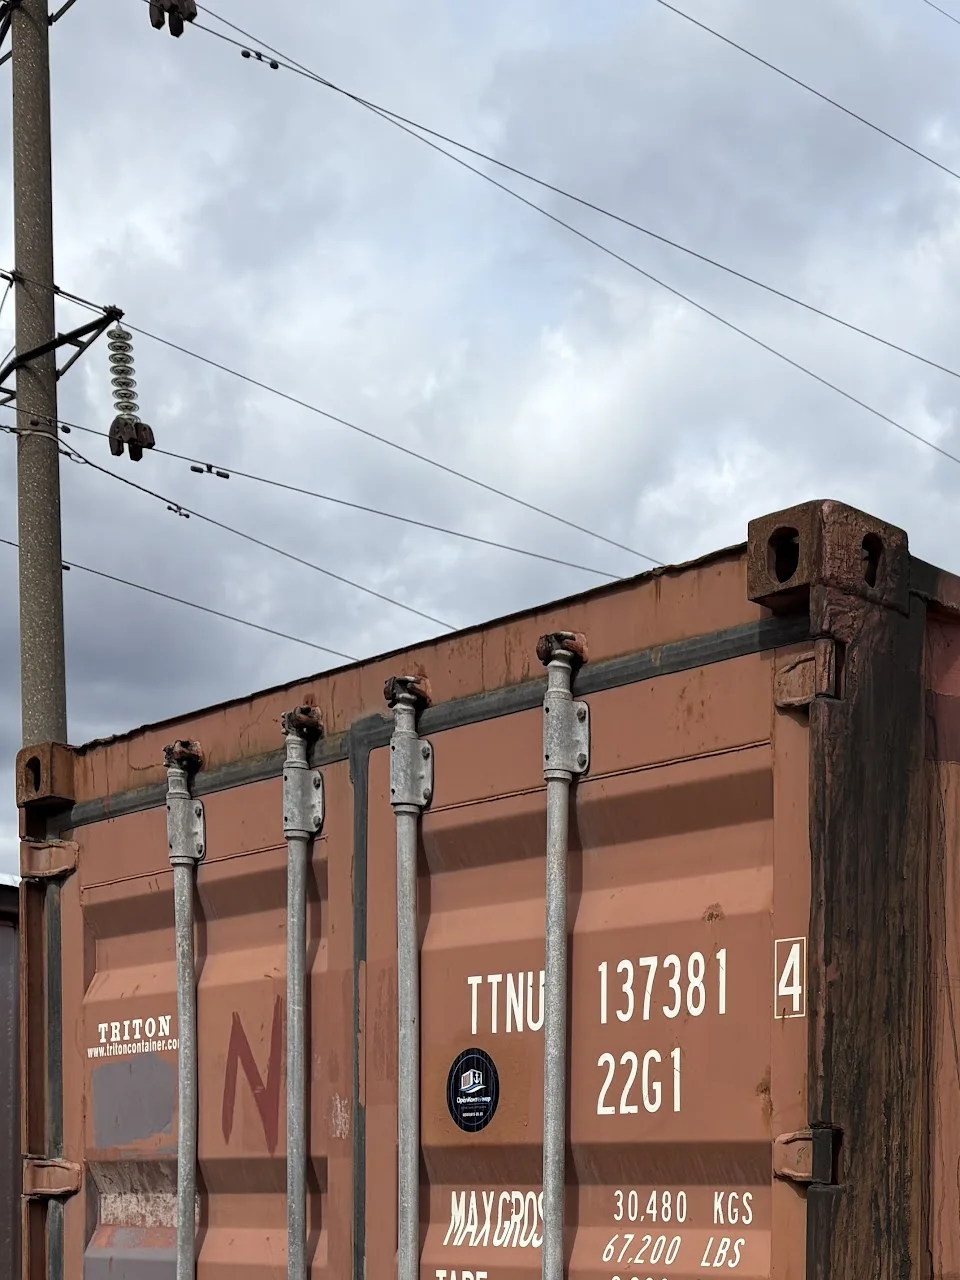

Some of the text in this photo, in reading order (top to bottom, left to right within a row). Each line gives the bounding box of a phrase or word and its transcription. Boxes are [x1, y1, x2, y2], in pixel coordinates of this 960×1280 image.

[467, 942, 803, 1035] TTNU 137381 4
[98, 1015, 172, 1043] TRITON
[87, 1037, 180, 1059] www.tritoncontainer.co
[596, 1047, 681, 1115] 22G1
[613, 1190, 687, 1222] 30,480
[713, 1191, 753, 1225] KGS
[602, 1234, 746, 1268] 67,200 LBS
